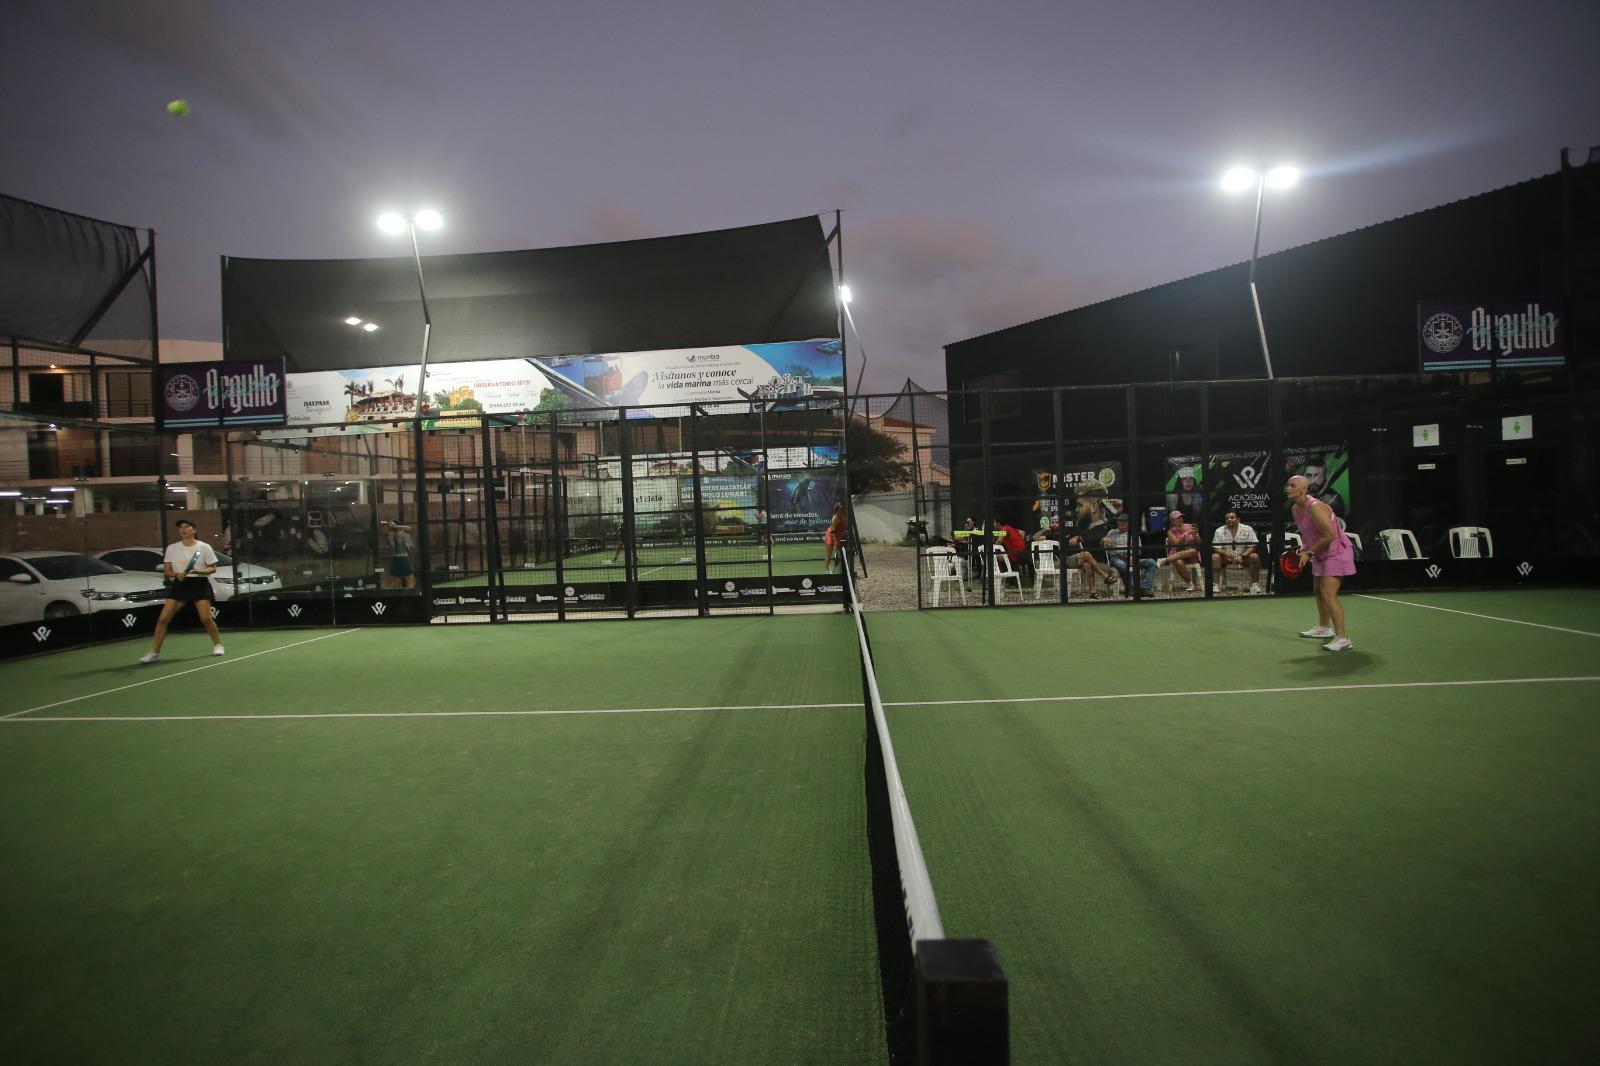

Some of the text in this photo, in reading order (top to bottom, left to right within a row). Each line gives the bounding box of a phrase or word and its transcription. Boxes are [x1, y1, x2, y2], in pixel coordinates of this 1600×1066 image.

[698, 373, 706, 381] y
[705, 368, 737, 378] conoce
[667, 381, 684, 389] vida
[685, 379, 712, 389] marina
[713, 377, 729, 386] más
[731, 376, 754, 386] cerca!
[1228, 493, 1270, 501] ACADEMIA
[1242, 500, 1268, 508] PADEL
